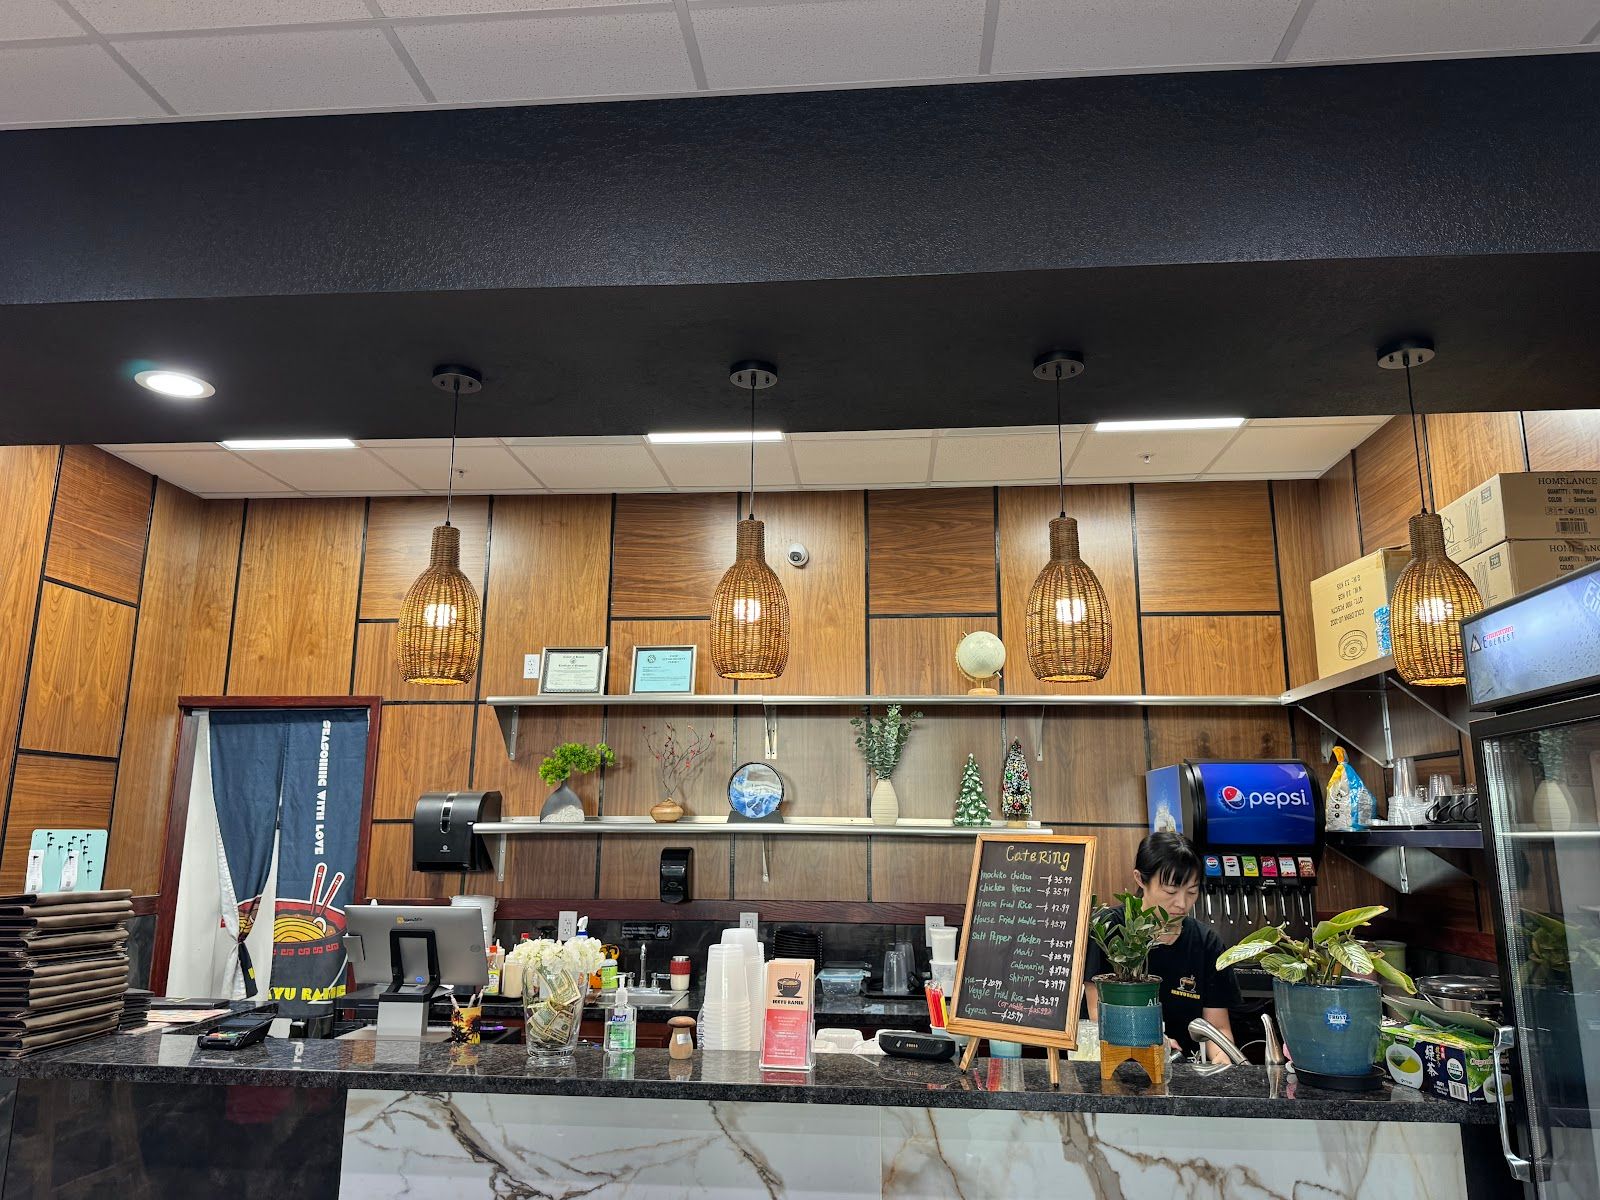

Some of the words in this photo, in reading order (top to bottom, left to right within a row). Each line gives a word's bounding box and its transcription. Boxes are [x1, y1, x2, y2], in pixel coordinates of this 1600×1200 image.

[318, 720, 331, 786] SEASONING
[316, 790, 326, 820] WITH
[1249, 789, 1306, 809] pepsi
[315, 824, 324, 854] LOVE
[977, 899, 997, 908] House
[1000, 899, 1015, 909] Fried
[1017, 899, 1032, 909] Rice
[974, 915, 996, 925] House
[999, 914, 1015, 924] Fried
[990, 931, 1012, 944] Pepper
[968, 986, 990, 1000] Veggie
[1011, 992, 1025, 1002] Rice
